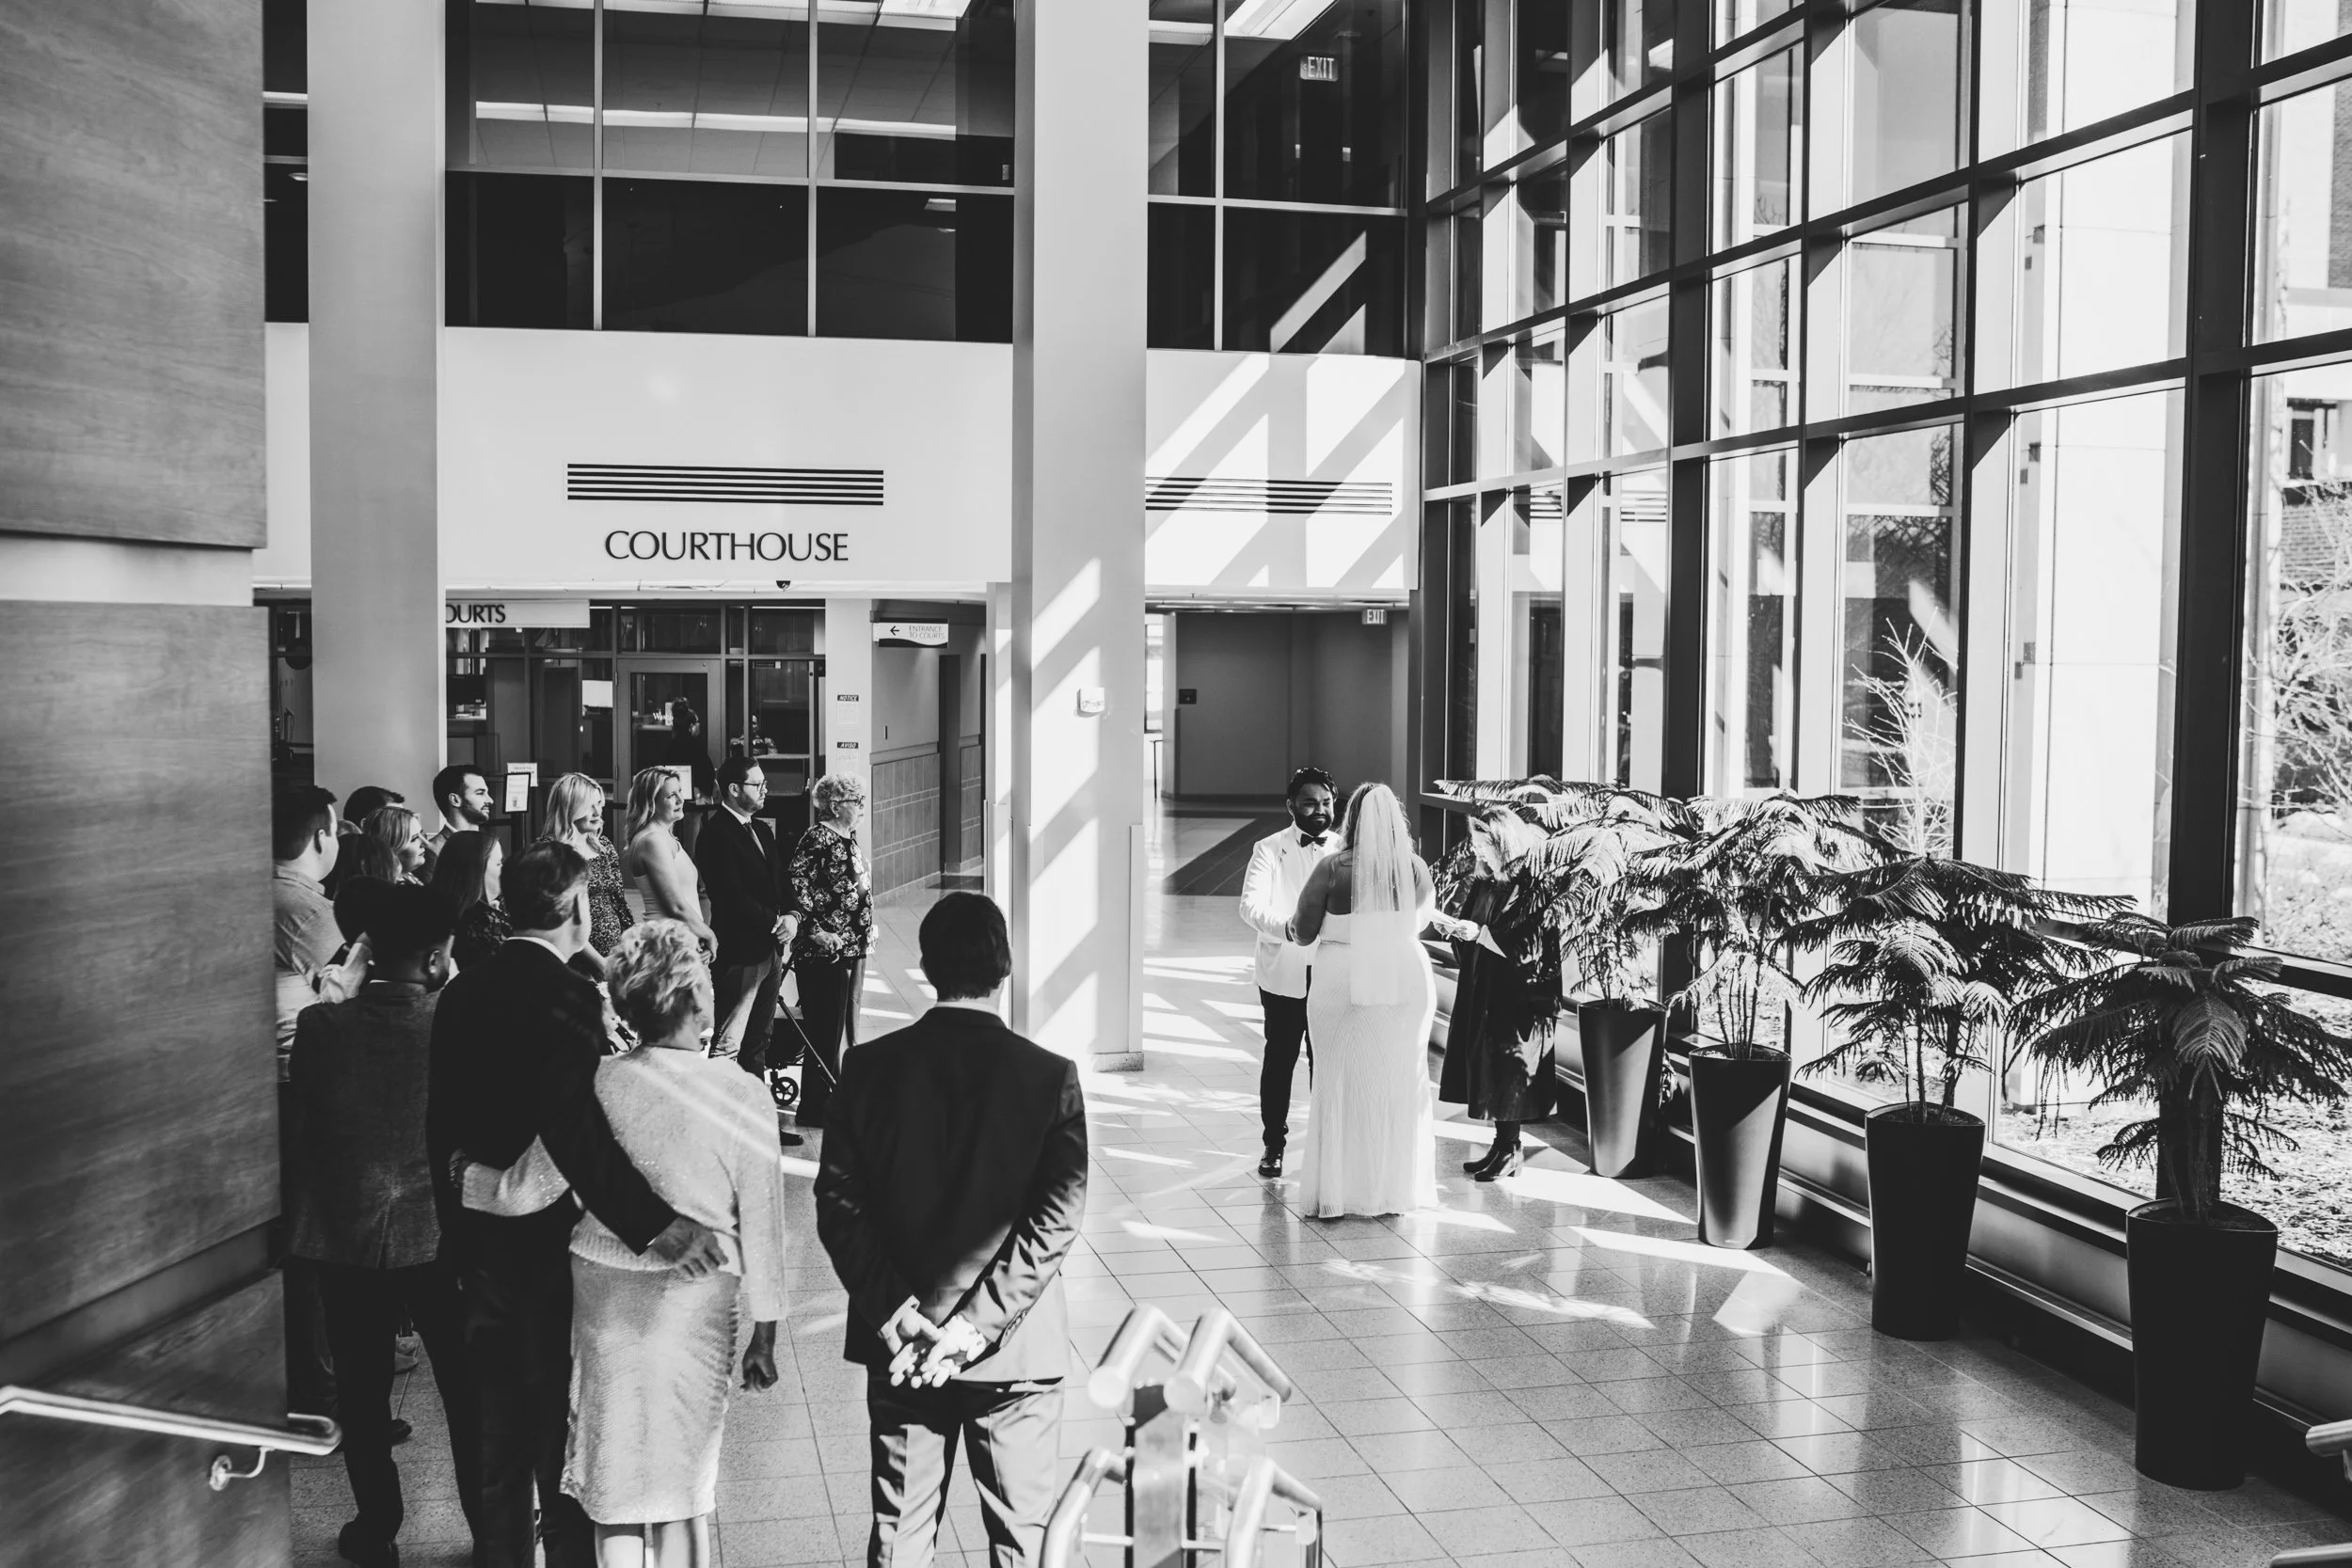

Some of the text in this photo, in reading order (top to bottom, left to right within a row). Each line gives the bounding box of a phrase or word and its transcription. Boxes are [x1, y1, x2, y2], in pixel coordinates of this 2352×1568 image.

[1308, 56, 1334, 79] EXIT
[604, 530, 849, 562] COURTHOUSE
[1366, 609, 1385, 625] EXIT
